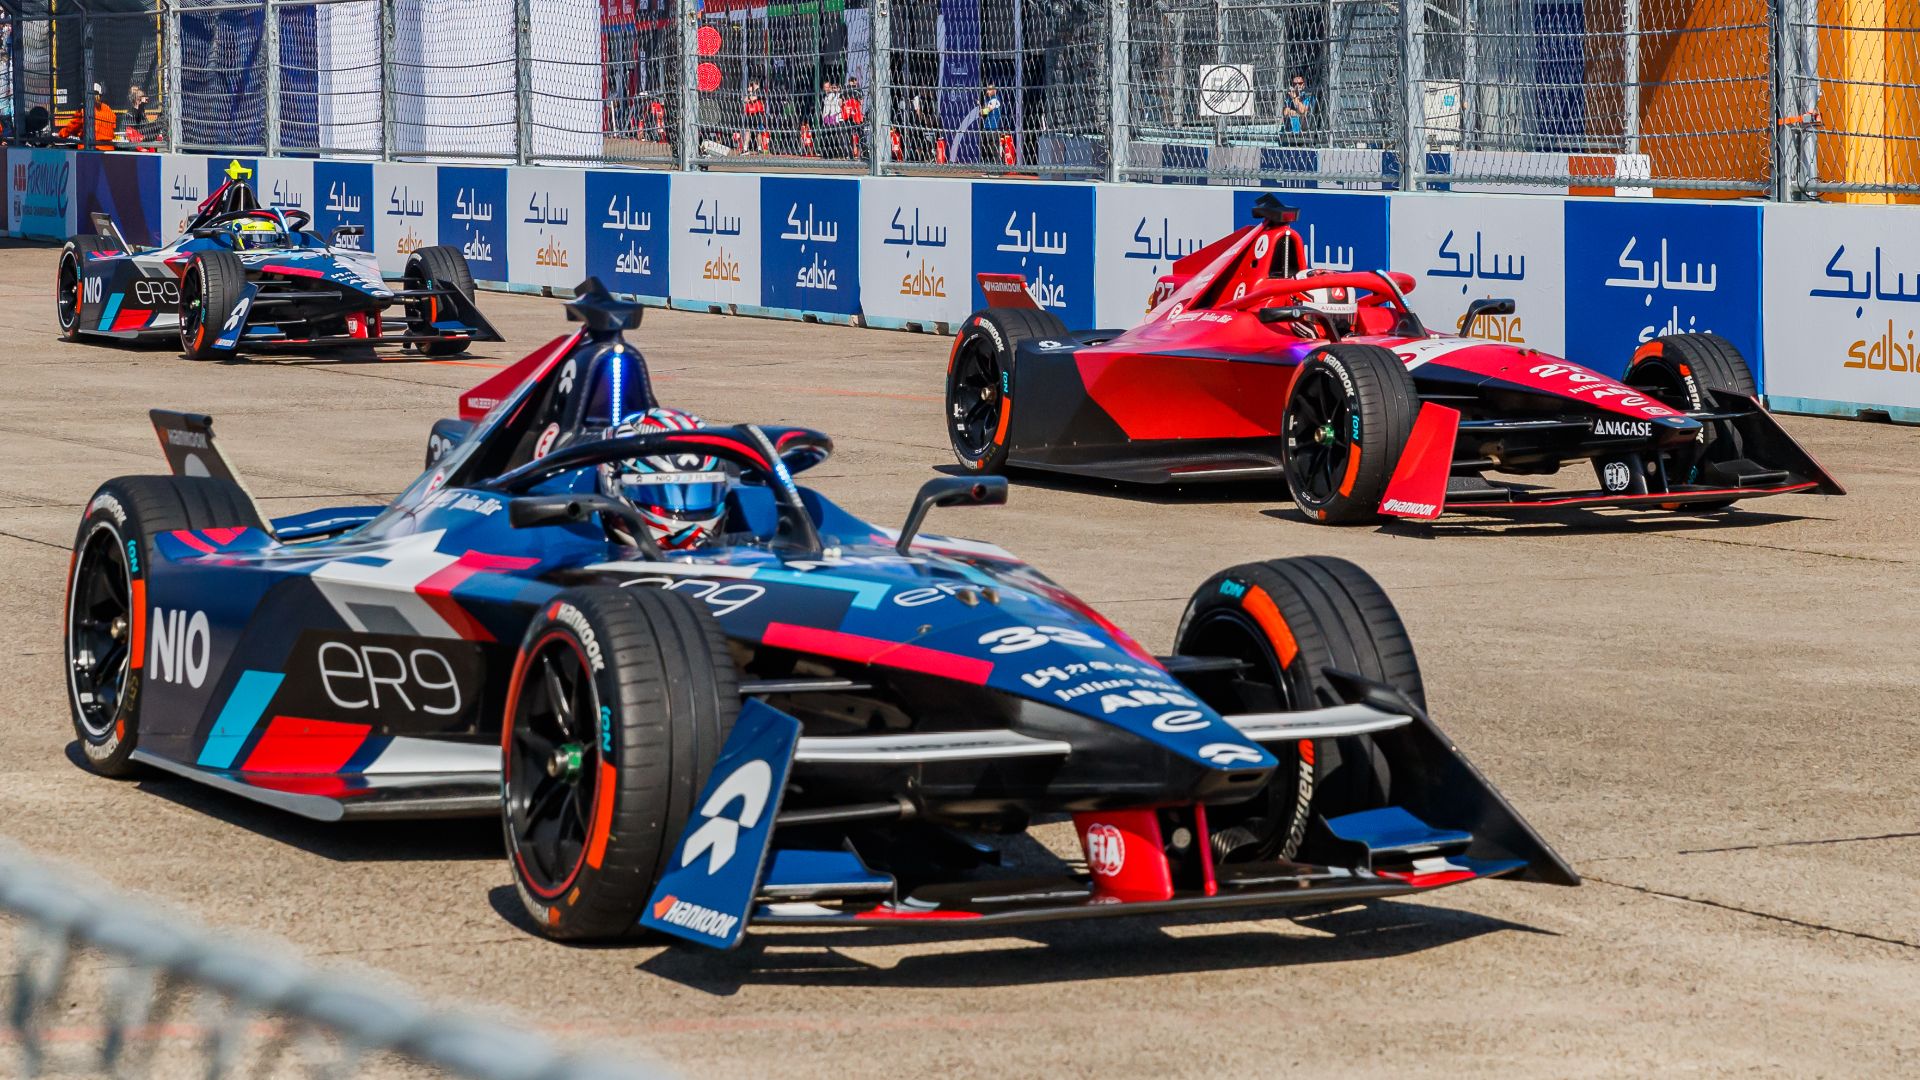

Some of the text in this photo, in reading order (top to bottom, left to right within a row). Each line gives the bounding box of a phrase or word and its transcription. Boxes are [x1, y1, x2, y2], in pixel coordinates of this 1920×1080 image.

[325, 181, 361, 220] سابك
[387, 185, 424, 225] سابك
[452, 188, 492, 230] سابك
[524, 191, 568, 235] سابك
[603, 194, 651, 241] سابك
[689, 199, 741, 246] سابك
[780, 202, 838, 253] سابك
[884, 206, 947, 259] سابك
[997, 210, 1066, 267] سابك
[463, 230, 493, 262] sabic
[536, 235, 568, 268] sabic
[615, 240, 651, 275] sabic
[703, 246, 741, 282] sabic
[1427, 229, 1525, 295] سابك
[83, 276, 102, 304] NIO
[796, 252, 838, 290] sabic
[900, 258, 946, 297] sabic
[990, 281, 1022, 293] Hankook
[1028, 266, 1066, 308] abic
[1605, 236, 1716, 307] سابك
[1154, 281, 1175, 305] 27
[1323, 353, 1355, 398] Hankook
[1604, 420, 1653, 436] NAGASE
[1390, 499, 1437, 516] Hankook
[150, 606, 211, 689] NIO
[556, 603, 605, 673] Hankook
[978, 625, 1106, 654] 33
[1087, 830, 1123, 868] FIA
[663, 899, 738, 939] Hankook
